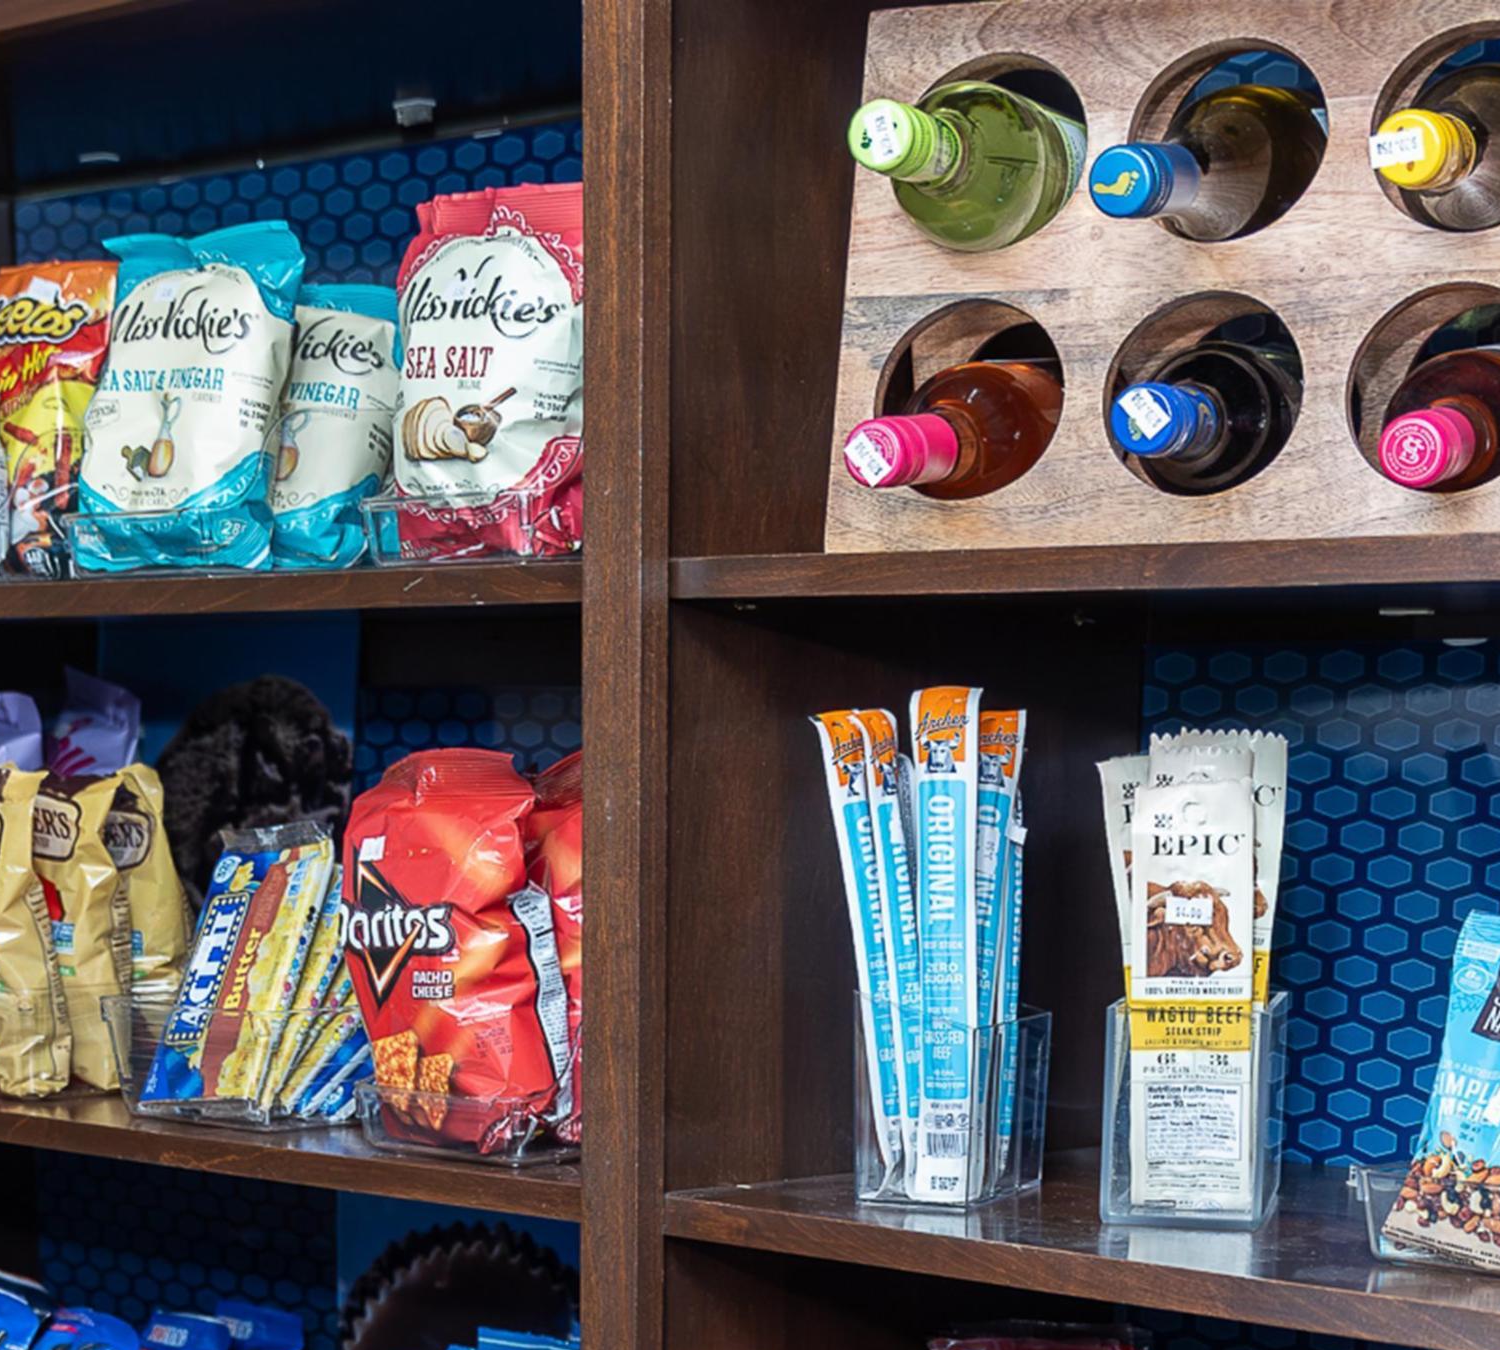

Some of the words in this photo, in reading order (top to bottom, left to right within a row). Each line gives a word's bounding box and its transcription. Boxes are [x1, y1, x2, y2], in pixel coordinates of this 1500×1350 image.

[448, 256, 560, 338] Vickie's
[161, 286, 253, 353] Vickie's
[406, 347, 438, 380] SEA
[444, 346, 494, 379] SALT
[124, 369, 155, 392] SALT
[168, 367, 223, 391] VINEGAR
[291, 382, 360, 409] VINEGAR
[915, 712, 970, 740] Archer
[1152, 834, 1241, 857] EPIC
[928, 795, 956, 925] ORIGINAL
[339, 903, 452, 949] Doritos
[225, 927, 262, 1017] Butter
[412, 970, 452, 985] NACHO
[925, 974, 964, 984] SUGAR
[926, 963, 958, 973] ZERO
[412, 984, 453, 999] CHEESE
[1147, 1006, 1196, 1024] WAGYU
[1207, 1006, 1244, 1024] BEEF
[1196, 1027, 1222, 1037] STRIP
